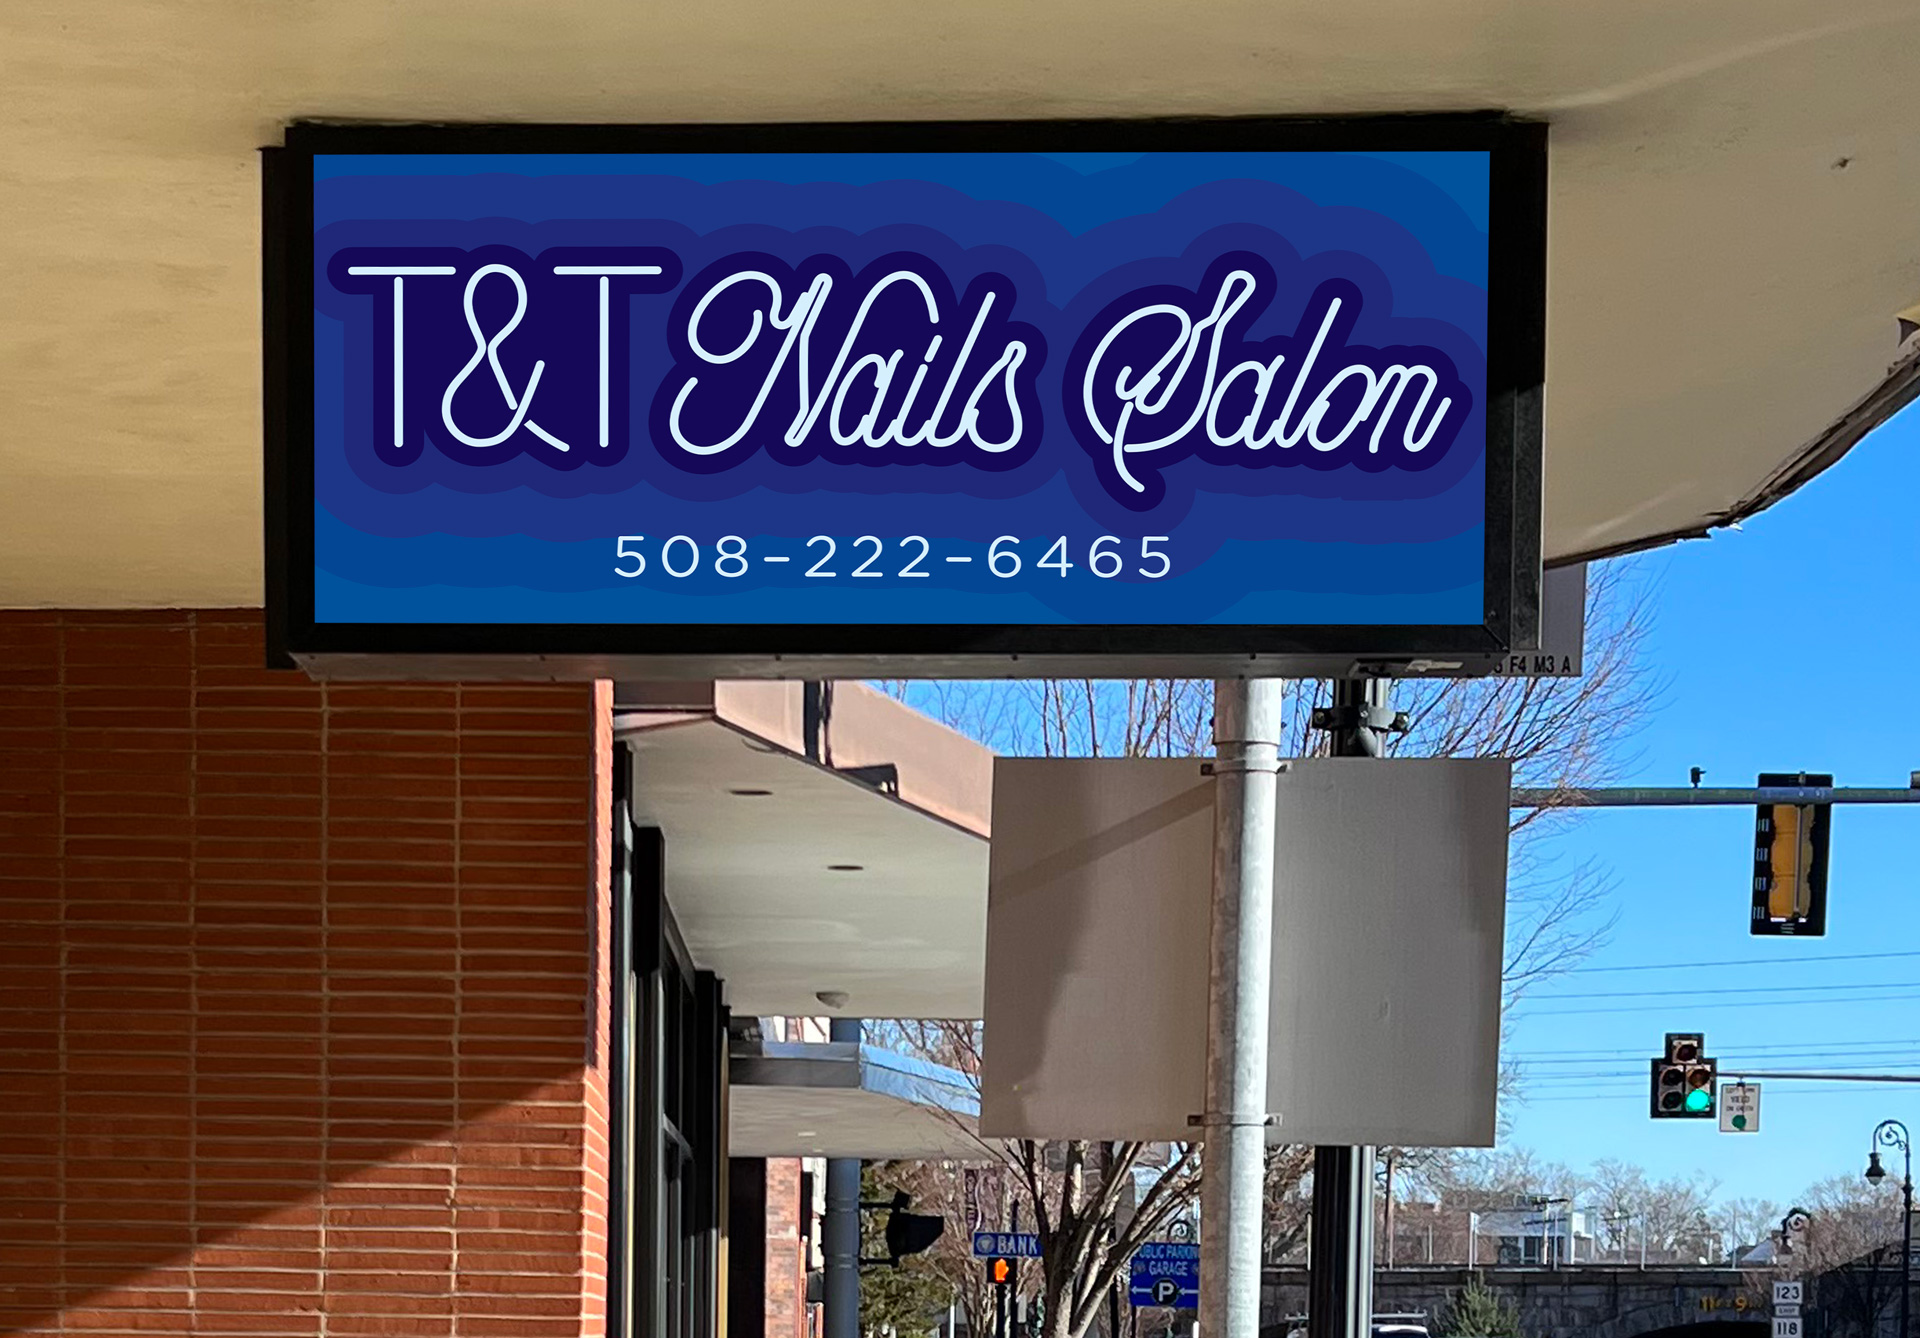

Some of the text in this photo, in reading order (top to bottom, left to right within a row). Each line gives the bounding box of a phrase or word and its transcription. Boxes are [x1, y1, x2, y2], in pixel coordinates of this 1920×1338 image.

[347, 263, 1454, 493] T&T Nails Salon
[613, 534, 1172, 579] 508-222-6465
[1510, 656, 1526, 674] F4
[1534, 655, 1554, 674] M3
[1561, 655, 1571, 673] A
[997, 1235, 1038, 1254] BANK
[1149, 1261, 1188, 1276] GARAGE
[1158, 1282, 1175, 1302] P
[1776, 1286, 1800, 1299] 123
[1777, 1322, 1798, 1335] 118
